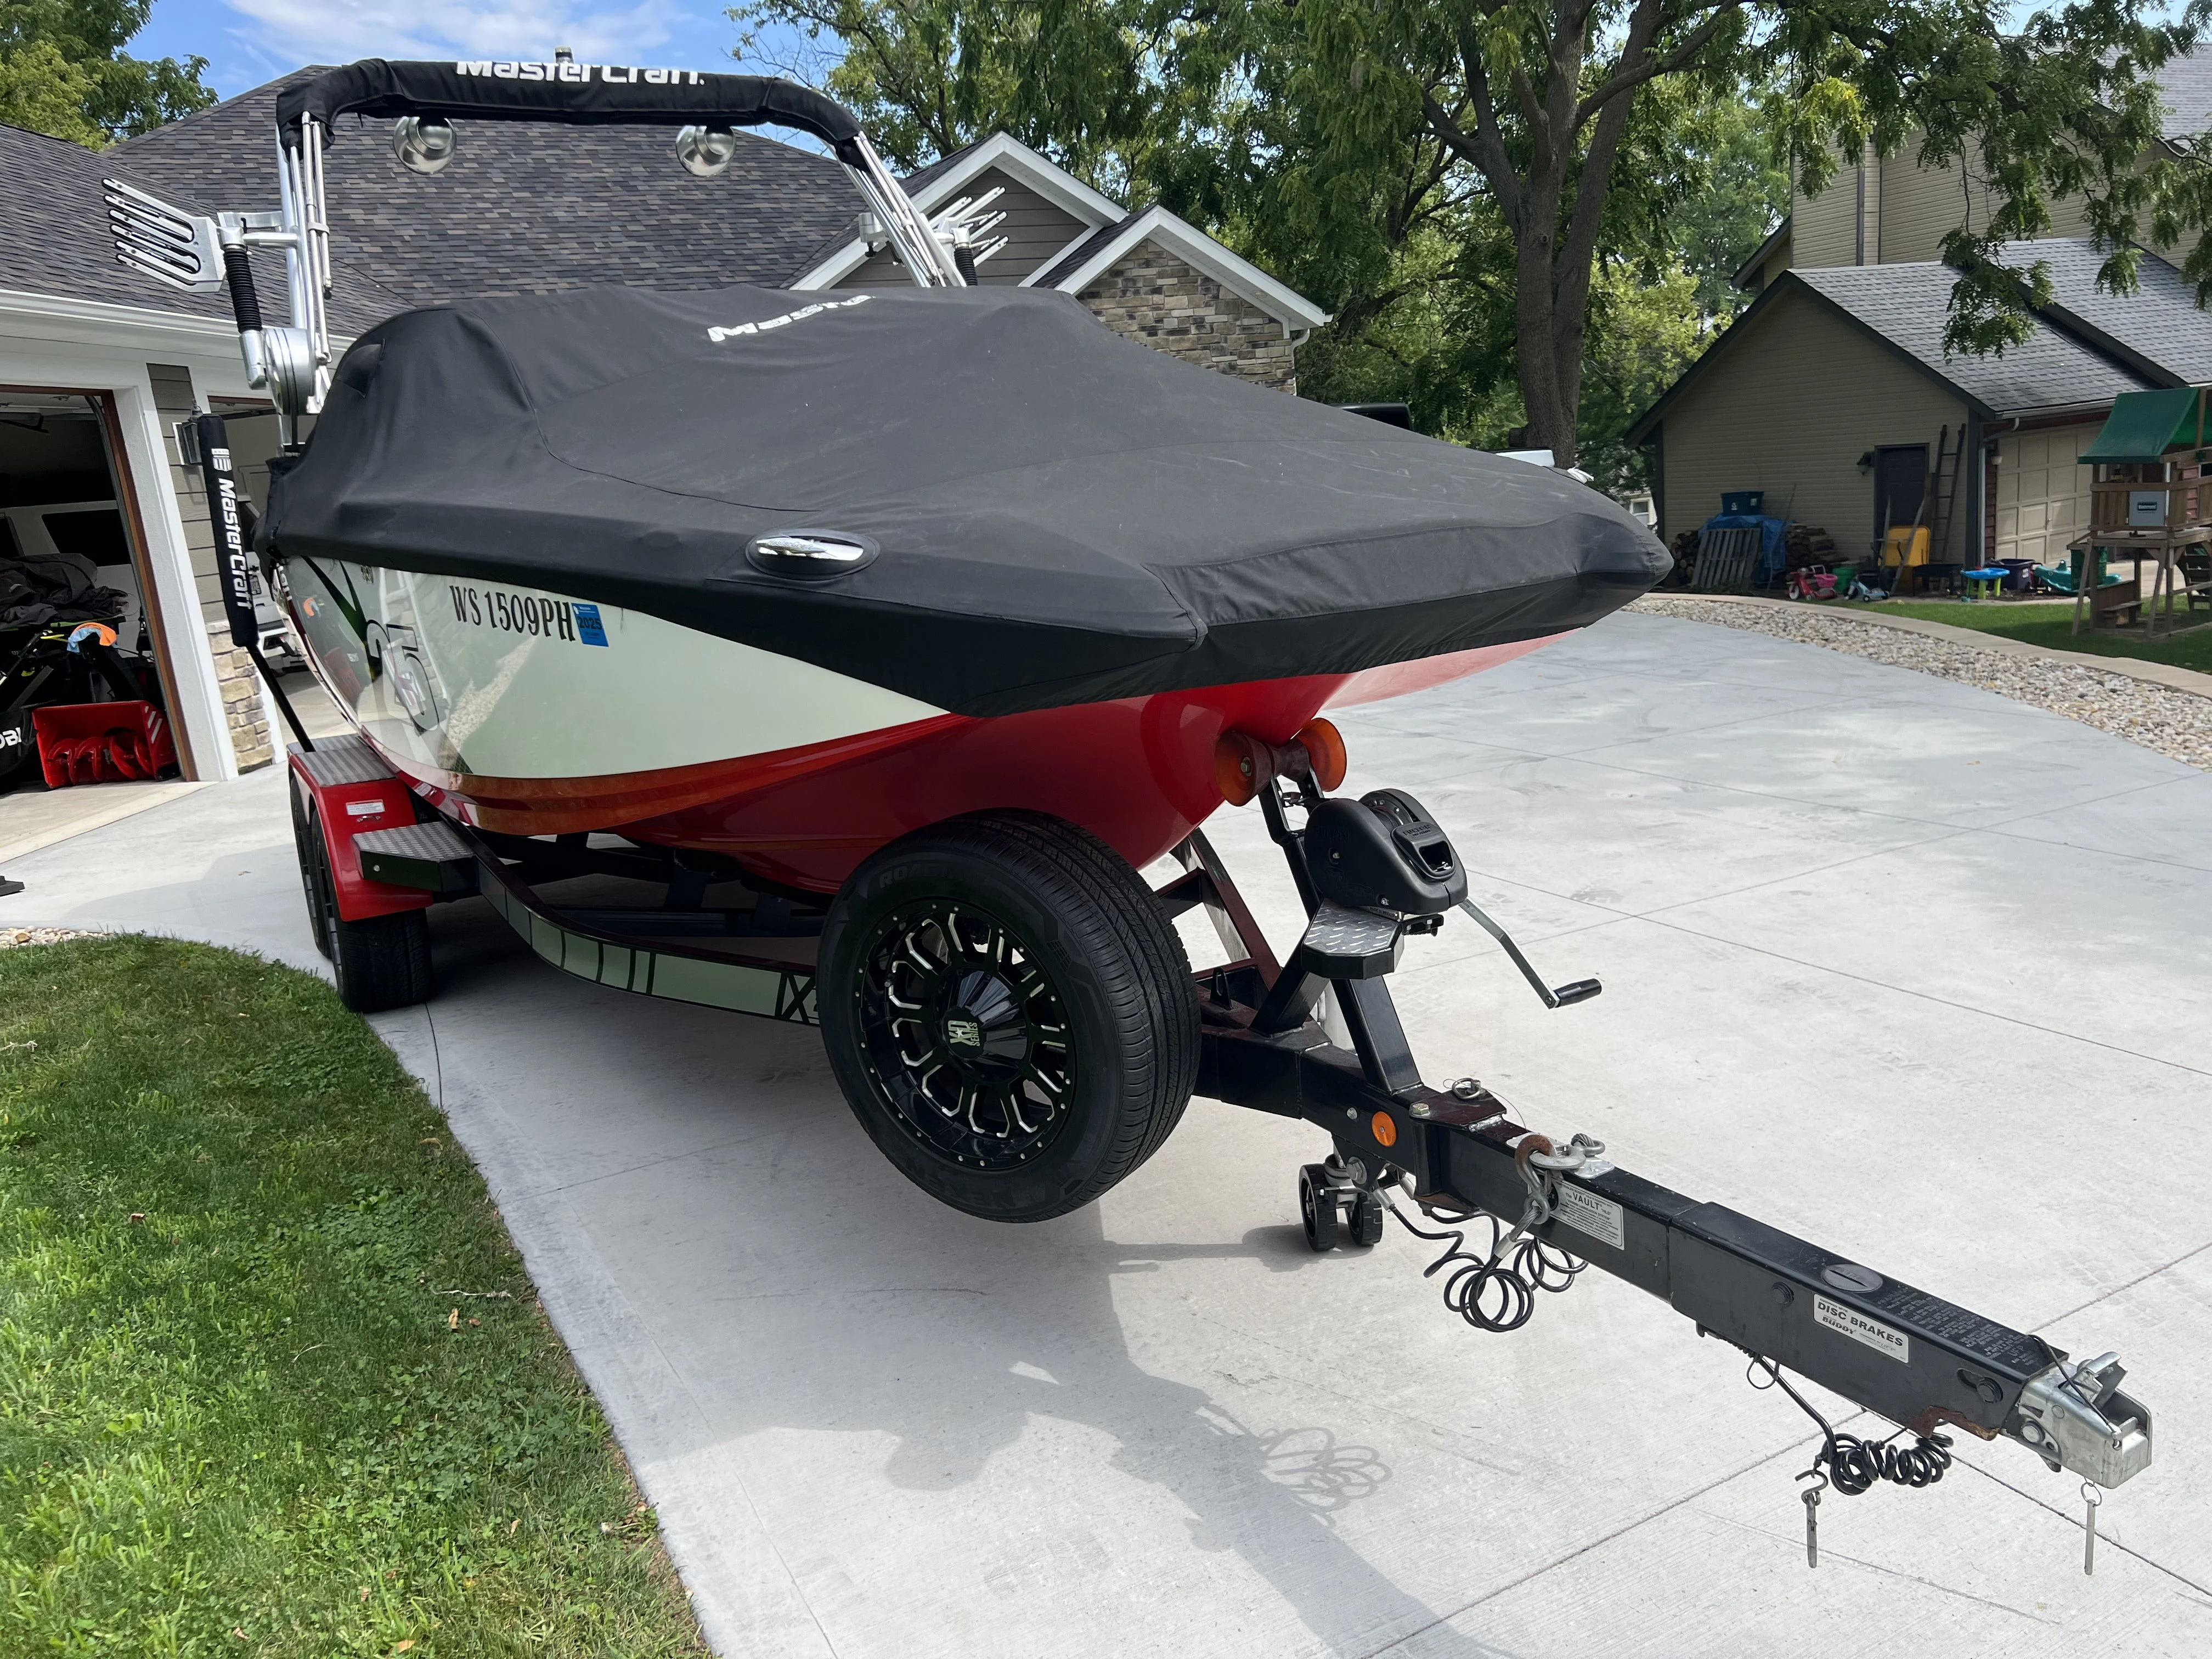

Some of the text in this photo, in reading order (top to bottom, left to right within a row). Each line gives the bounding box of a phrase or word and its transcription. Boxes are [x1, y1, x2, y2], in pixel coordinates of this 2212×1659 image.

[218, 477, 252, 610] MasterCraft
[449, 585, 482, 626] WS
[577, 616, 602, 630] 2025
[969, 1022, 980, 1047] SERIES
[1818, 1301, 1847, 1320] DISC
[1850, 1316, 1904, 1347] BRAKES
[1822, 1316, 1857, 1334] BUDDY
